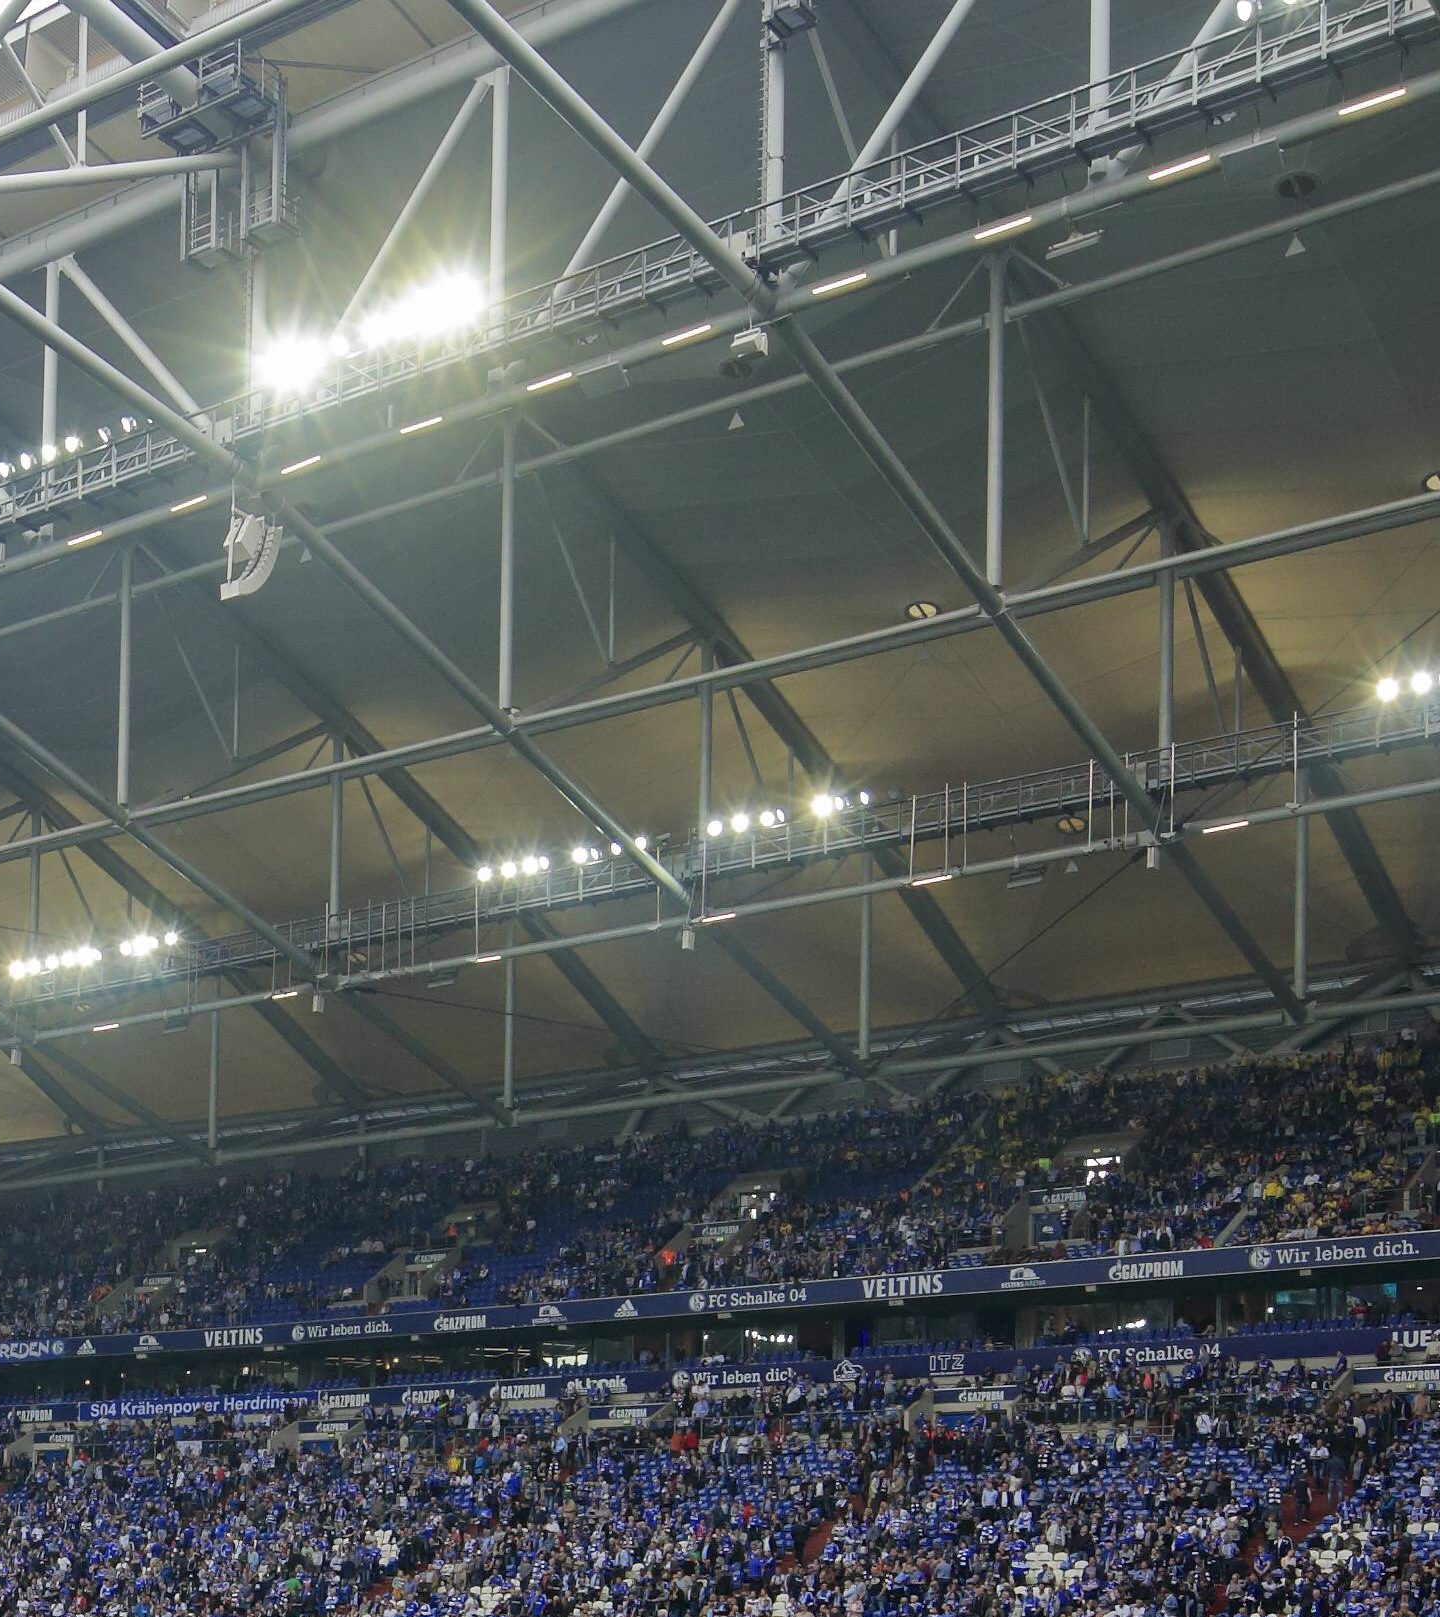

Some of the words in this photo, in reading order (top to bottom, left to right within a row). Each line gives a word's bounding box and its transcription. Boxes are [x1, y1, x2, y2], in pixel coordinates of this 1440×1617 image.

[1275, 1246, 1310, 1264] Wir
[1314, 1243, 1367, 1262] leben
[1372, 1239, 1420, 1258] dich.
[1121, 1261, 1184, 1280] GAZPROM
[862, 1274, 943, 1298] VELTINS
[708, 1294, 727, 1308] FC
[731, 1290, 785, 1306] Schalke
[789, 1287, 807, 1302] 04
[307, 1325, 329, 1338] Wir
[332, 1322, 361, 1336] leben
[364, 1320, 392, 1334] dich.
[443, 1314, 486, 1331] GAZPROM
[204, 1327, 263, 1348] VELTINS
[930, 1354, 965, 1372] ITZ
[1125, 1344, 1193, 1364] Schalke
[692, 1371, 717, 1386] Wir
[722, 1370, 761, 1385] leben
[1395, 1369, 1440, 1382] GAZPROM
[328, 1391, 370, 1408] GAZPROM
[500, 1382, 546, 1401] GAZPROM
[968, 1390, 1005, 1403] GAZPROM
[89, 1402, 117, 1418] S04
[120, 1397, 220, 1419] Krähenpower
